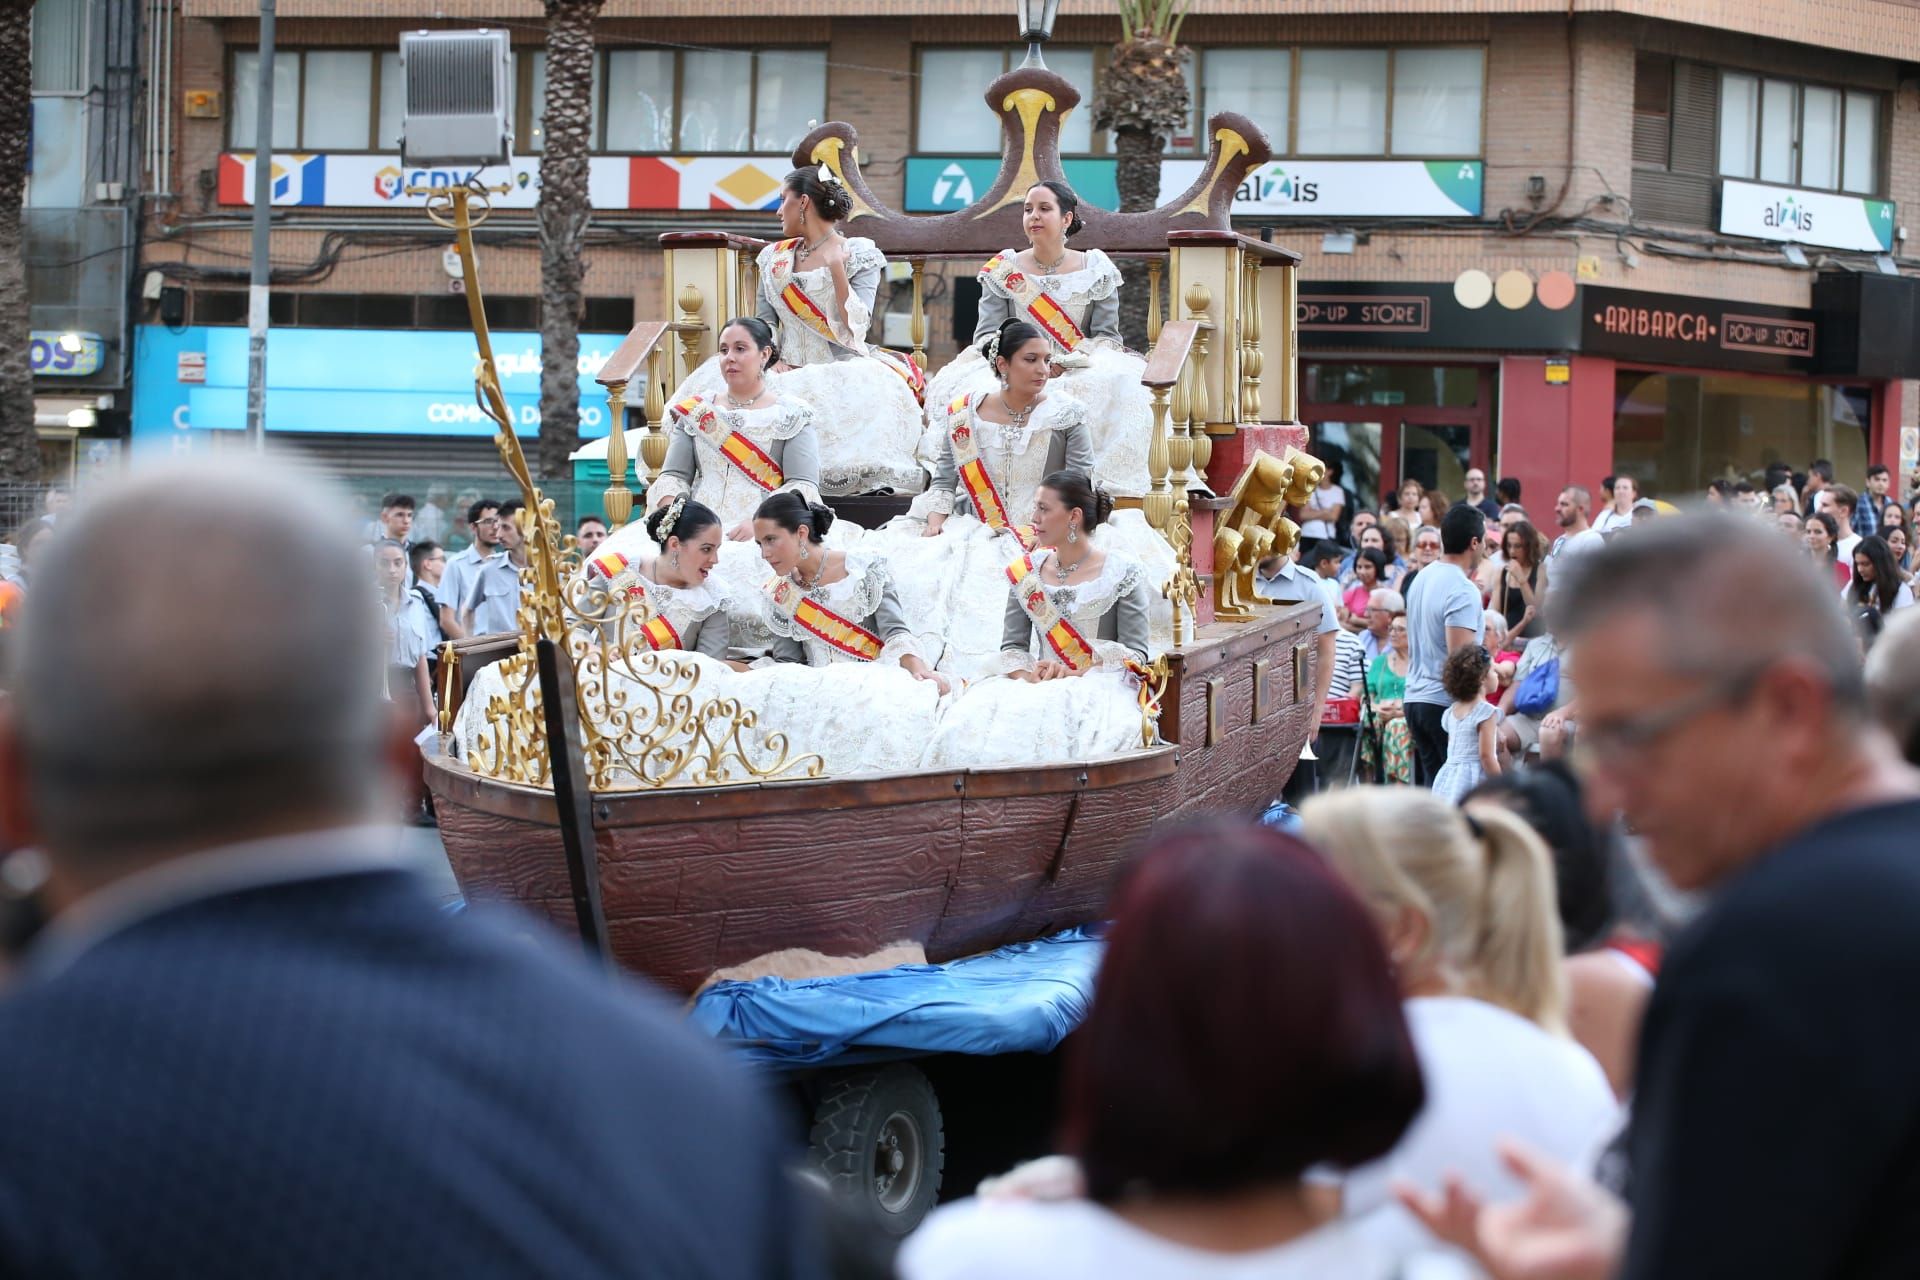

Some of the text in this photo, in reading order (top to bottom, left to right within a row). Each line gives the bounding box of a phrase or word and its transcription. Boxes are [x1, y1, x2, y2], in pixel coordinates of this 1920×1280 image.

[1297, 303, 1417, 324] OP-UP STORE
[1604, 305, 1808, 348] ARIBARCA POP-UP STORE
